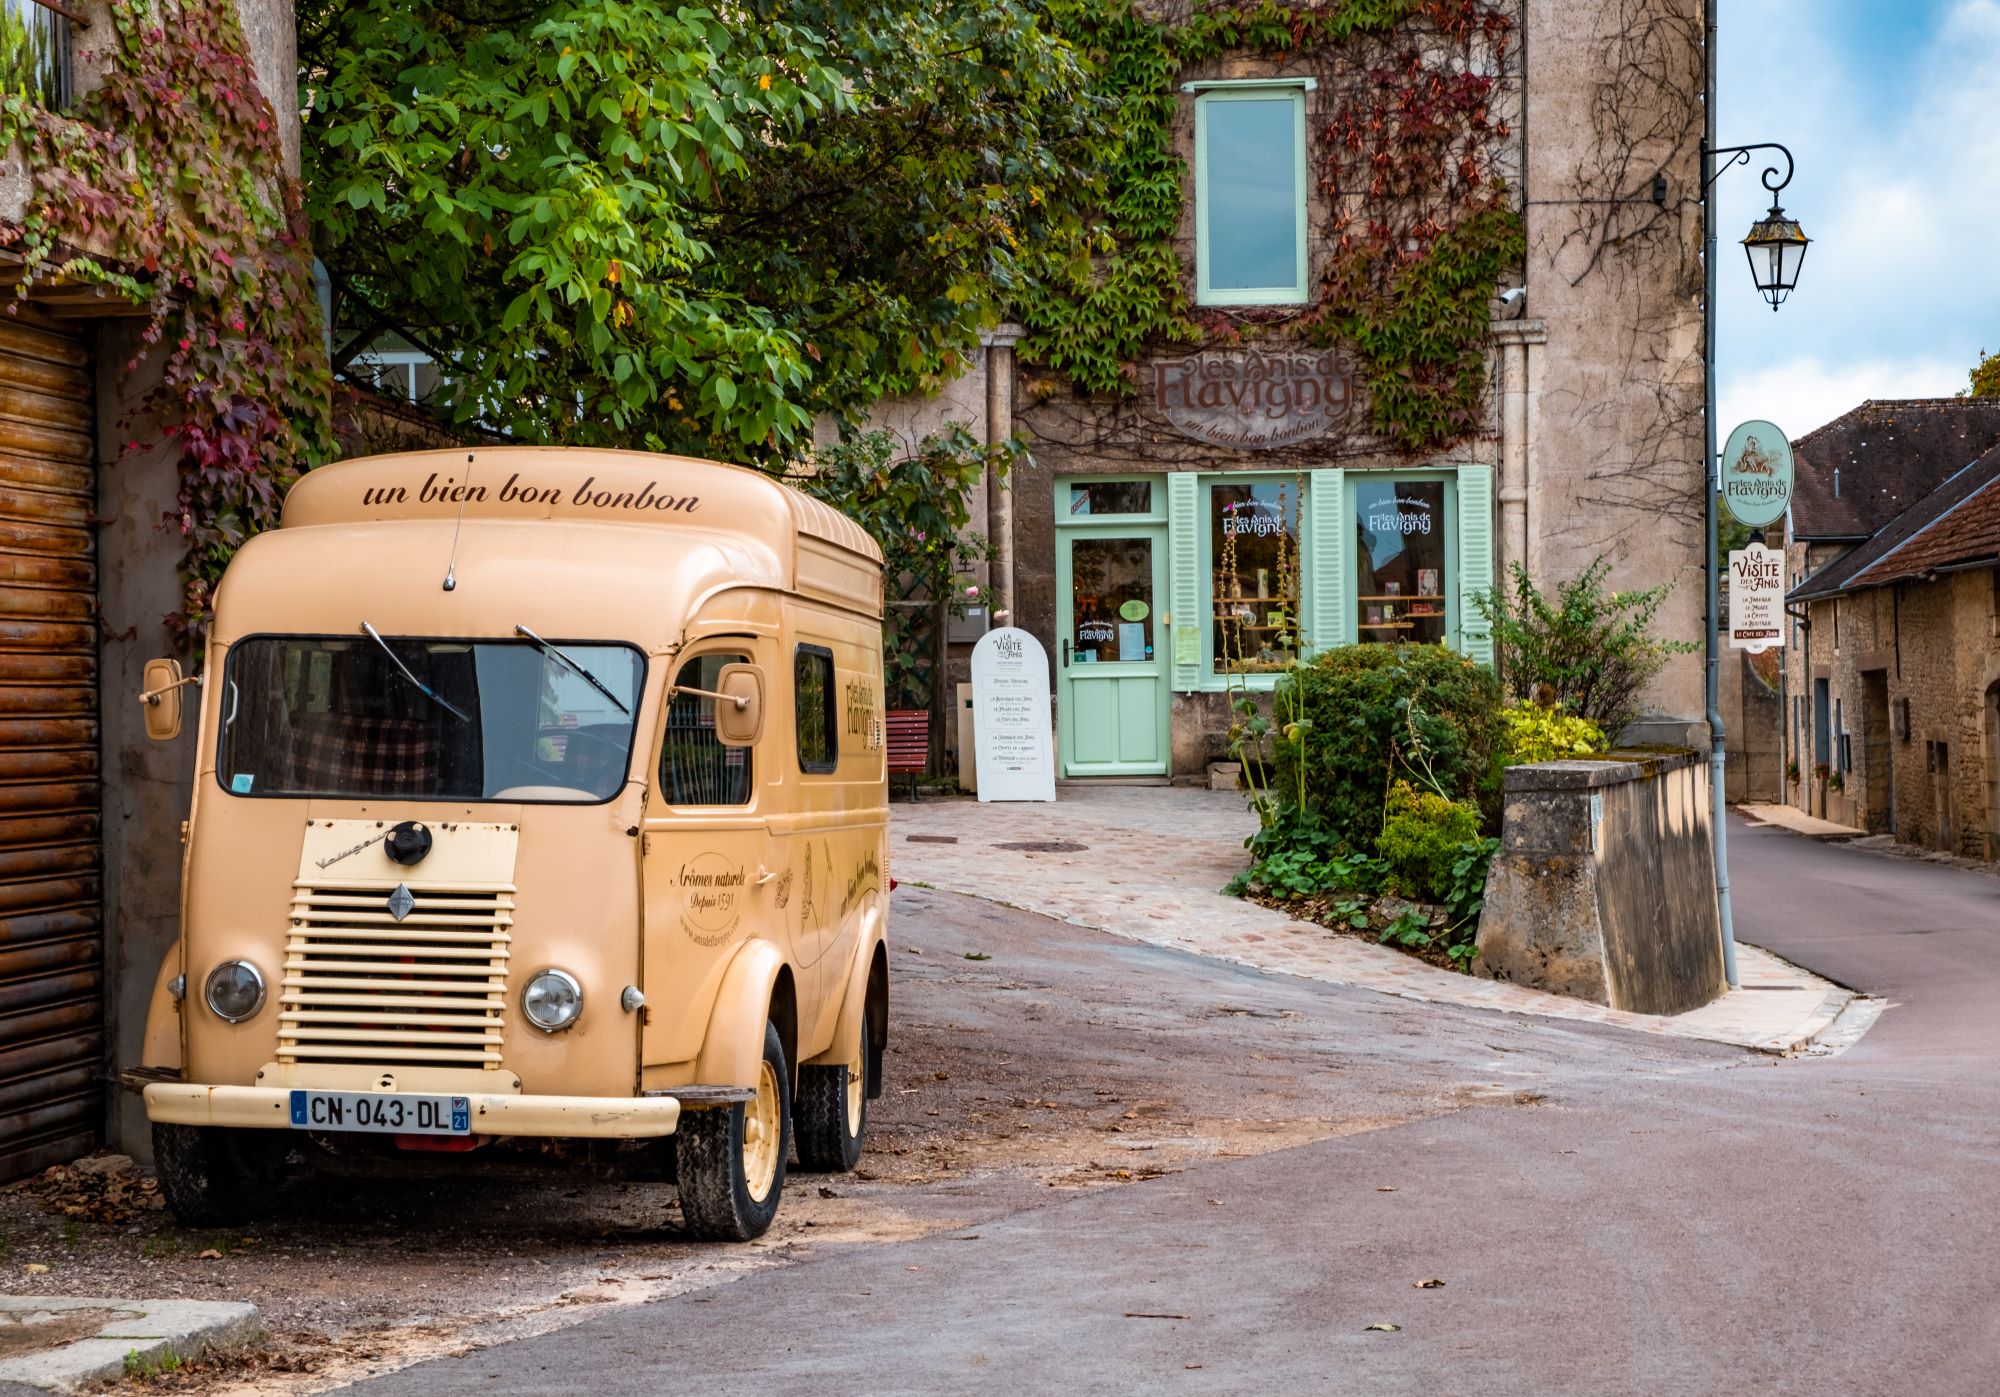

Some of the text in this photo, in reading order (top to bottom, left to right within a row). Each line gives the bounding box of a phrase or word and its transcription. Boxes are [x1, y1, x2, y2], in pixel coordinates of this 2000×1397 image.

[1198, 351, 1351, 379] les Anis de
[1156, 362, 1351, 419] Flavigny
[1184, 419, 1320, 443] un bien bon bonbon
[363, 472, 701, 513] un bien bon bonbon
[1728, 481, 1787, 499] Flavigny
[1754, 478, 1774, 488] Anis
[1775, 479, 1787, 487] de
[1251, 514, 1272, 525] Anis
[1369, 515, 1431, 535] Flavigny
[1397, 511, 1418, 521] Anis
[1419, 512, 1431, 521] de
[1750, 551, 1763, 564] LA
[1003, 634, 1011, 642] LA
[846, 685, 878, 751] Flavign
[670, 864, 745, 887] Arômes naturels
[691, 892, 734, 915] Depuis 1591
[311, 1097, 450, 1129] CN-043-DL
[454, 1115, 467, 1129] 21
